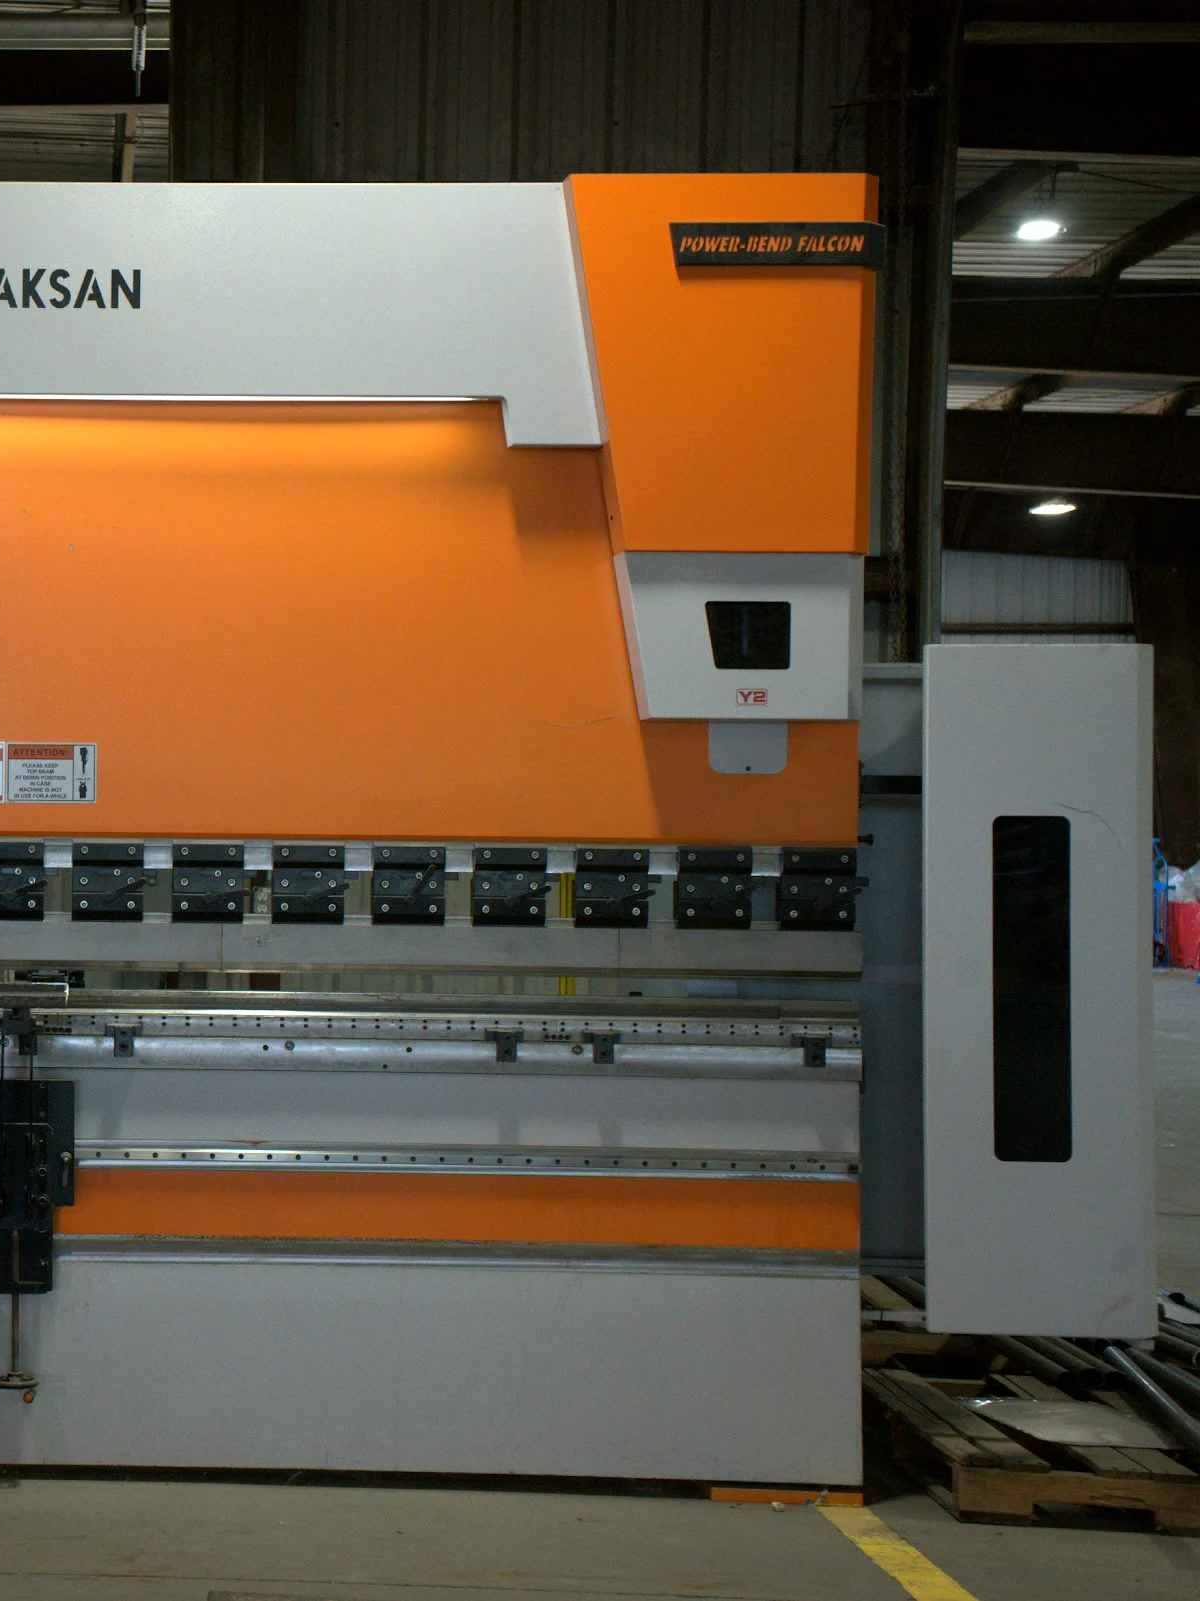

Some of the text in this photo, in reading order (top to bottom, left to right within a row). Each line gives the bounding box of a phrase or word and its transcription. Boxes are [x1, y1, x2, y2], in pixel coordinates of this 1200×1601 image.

[679, 234, 866, 253] POWER-BEND FALCON
[738, 690, 766, 703] Y2
[13, 748, 69, 757] ATTENTION!
